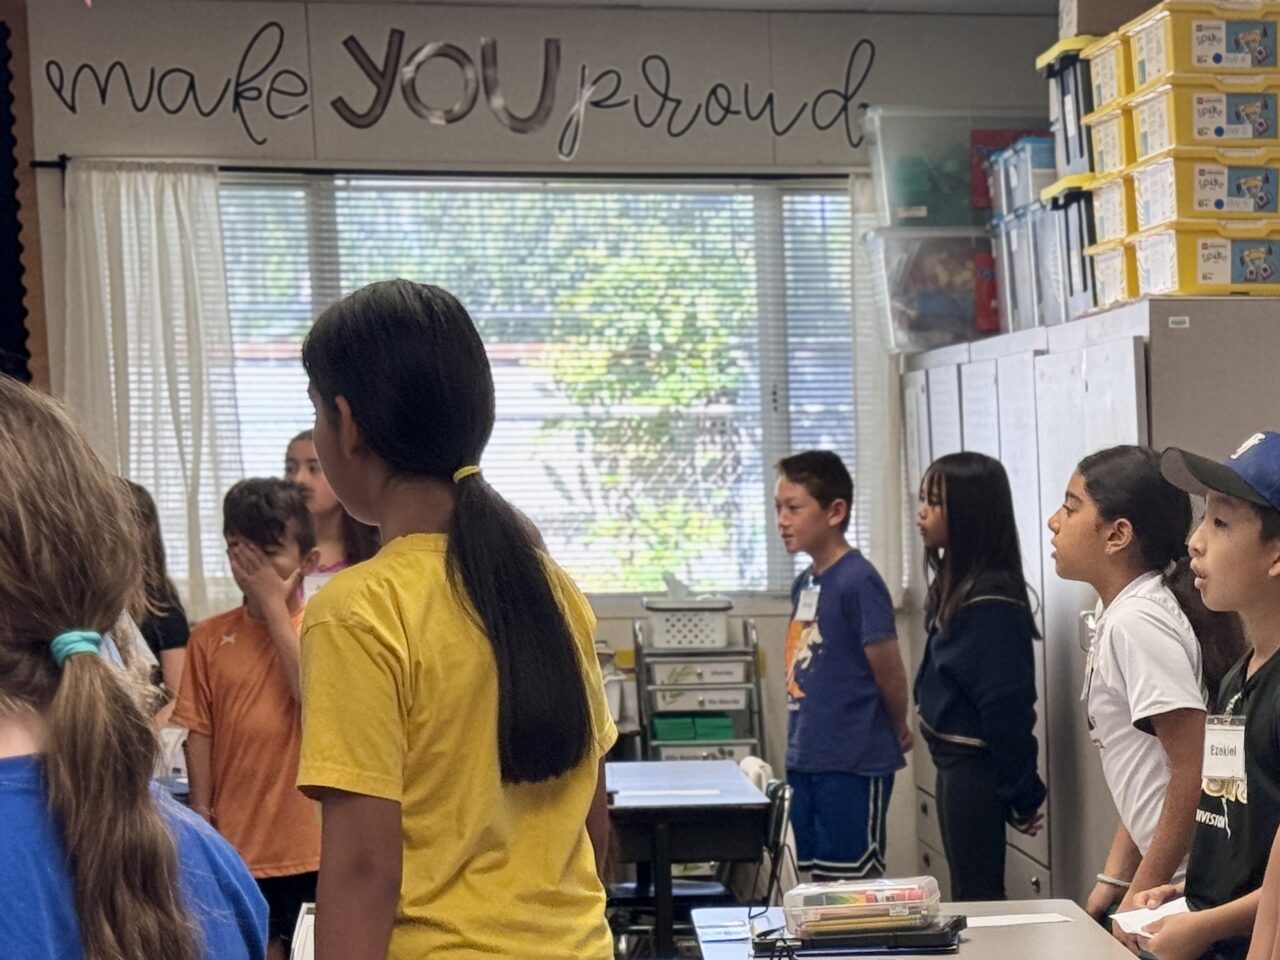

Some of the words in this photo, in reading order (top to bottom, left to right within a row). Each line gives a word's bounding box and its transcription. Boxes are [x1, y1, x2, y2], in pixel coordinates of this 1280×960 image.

[46, 21, 309, 145] make
[331, 28, 561, 134] YOU
[559, 38, 876, 161] proud
[1210, 744, 1237, 757] Ezekiel
